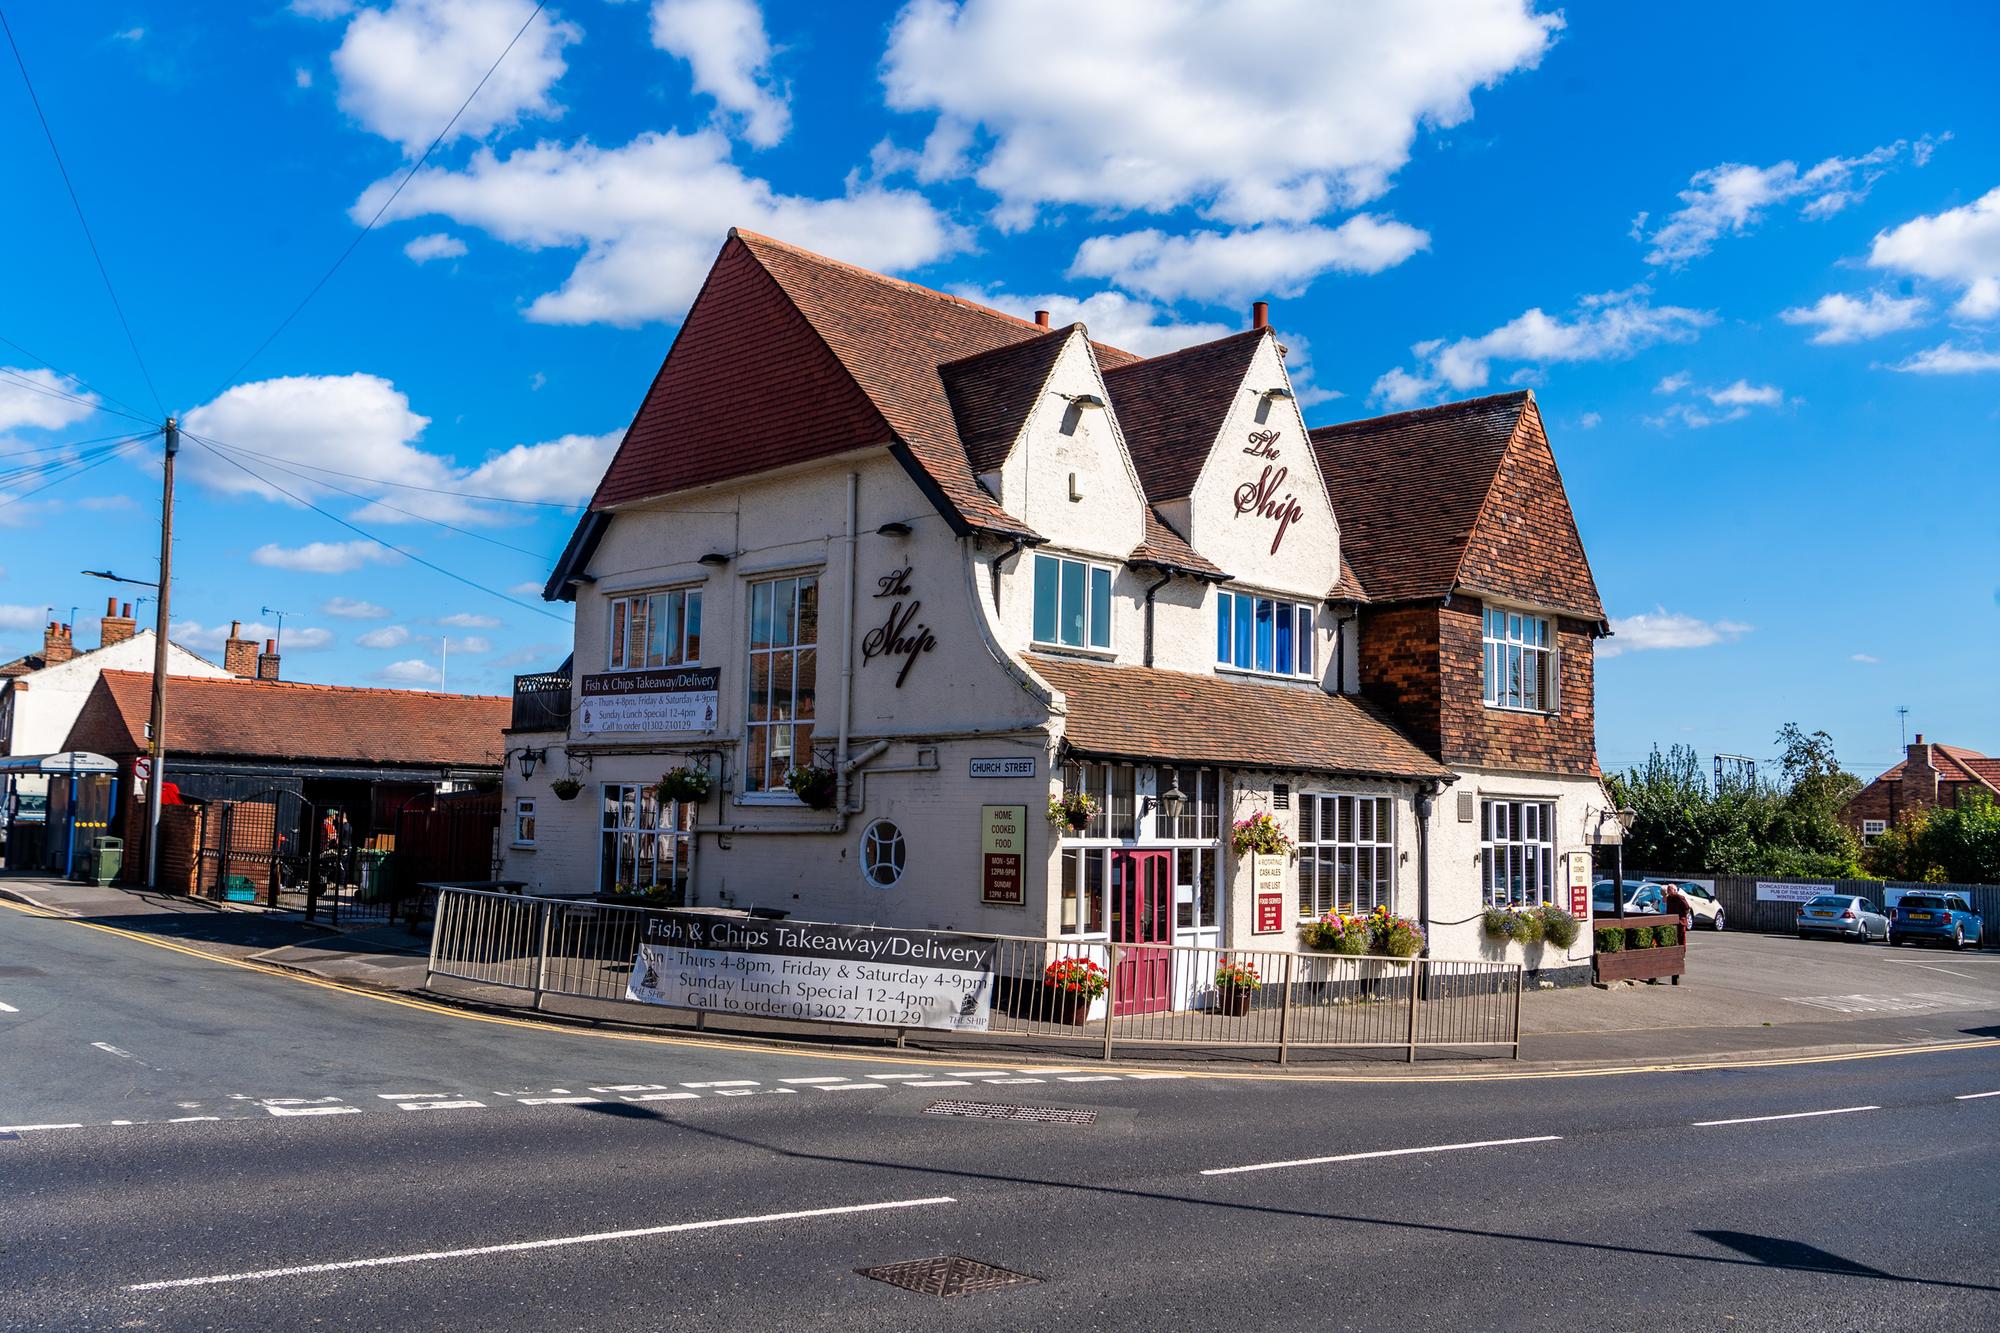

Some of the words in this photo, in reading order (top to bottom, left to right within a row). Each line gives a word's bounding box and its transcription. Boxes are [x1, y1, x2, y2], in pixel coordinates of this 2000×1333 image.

[1243, 430, 1280, 460] The
[1234, 465, 1303, 555] Ship
[873, 567, 912, 597] The
[862, 601, 936, 688] Ship
[585, 678, 600, 691] Fish
[602, 679, 609, 690] &
[611, 677, 634, 693] Chips
[636, 673, 717, 691] Takeaway/Delivery
[599, 698, 613, 706] Thurs
[639, 696, 656, 707] Friday
[666, 694, 692, 706] Saturday
[695, 694, 716, 705] 4-9pm
[600, 710, 620, 720] Sunday
[623, 709, 642, 718] Lunch
[644, 708, 667, 720] Special
[670, 707, 696, 719] 12-4pm
[603, 721, 615, 730] Call
[617, 721, 622, 729] to
[624, 720, 641, 729] order
[642, 720, 663, 730] 01302
[665, 720, 691, 730] 710129
[972, 762, 1000, 773] CHURCH
[1004, 762, 1032, 773] STREET
[994, 810, 1012, 820] HOME
[991, 825, 1016, 834] COOKED
[995, 838, 1012, 848] FOOD
[991, 857, 1002, 865] MON
[1260, 868, 1270, 876] CASK
[1271, 868, 1281, 876] ALES
[647, 919, 682, 939] Fish
[690, 922, 703, 941] &
[711, 923, 769, 950] Chips
[775, 928, 986, 969] Takeaway/Delivery
[643, 948, 664, 963] Sun
[678, 951, 715, 968] Thurs
[720, 956, 775, 975] 4-8pm,
[782, 960, 831, 981] Friday
[837, 964, 850, 978] &
[856, 966, 928, 989] Saturday
[934, 973, 987, 993] 4-9pm
[630, 986, 647, 996] THE
[680, 972, 735, 994] Sunday
[741, 978, 790, 995] Lunch
[796, 982, 858, 1001] Special
[867, 988, 934, 1009] 12-4pm
[688, 993, 718, 1007] Call
[724, 998, 739, 1010] to
[744, 999, 787, 1014] order
[793, 1001, 846, 1019] 01302
[854, 1006, 921, 1024] 710129
[949, 1015, 965, 1024] THE
[966, 1017, 987, 1026] SHIP
